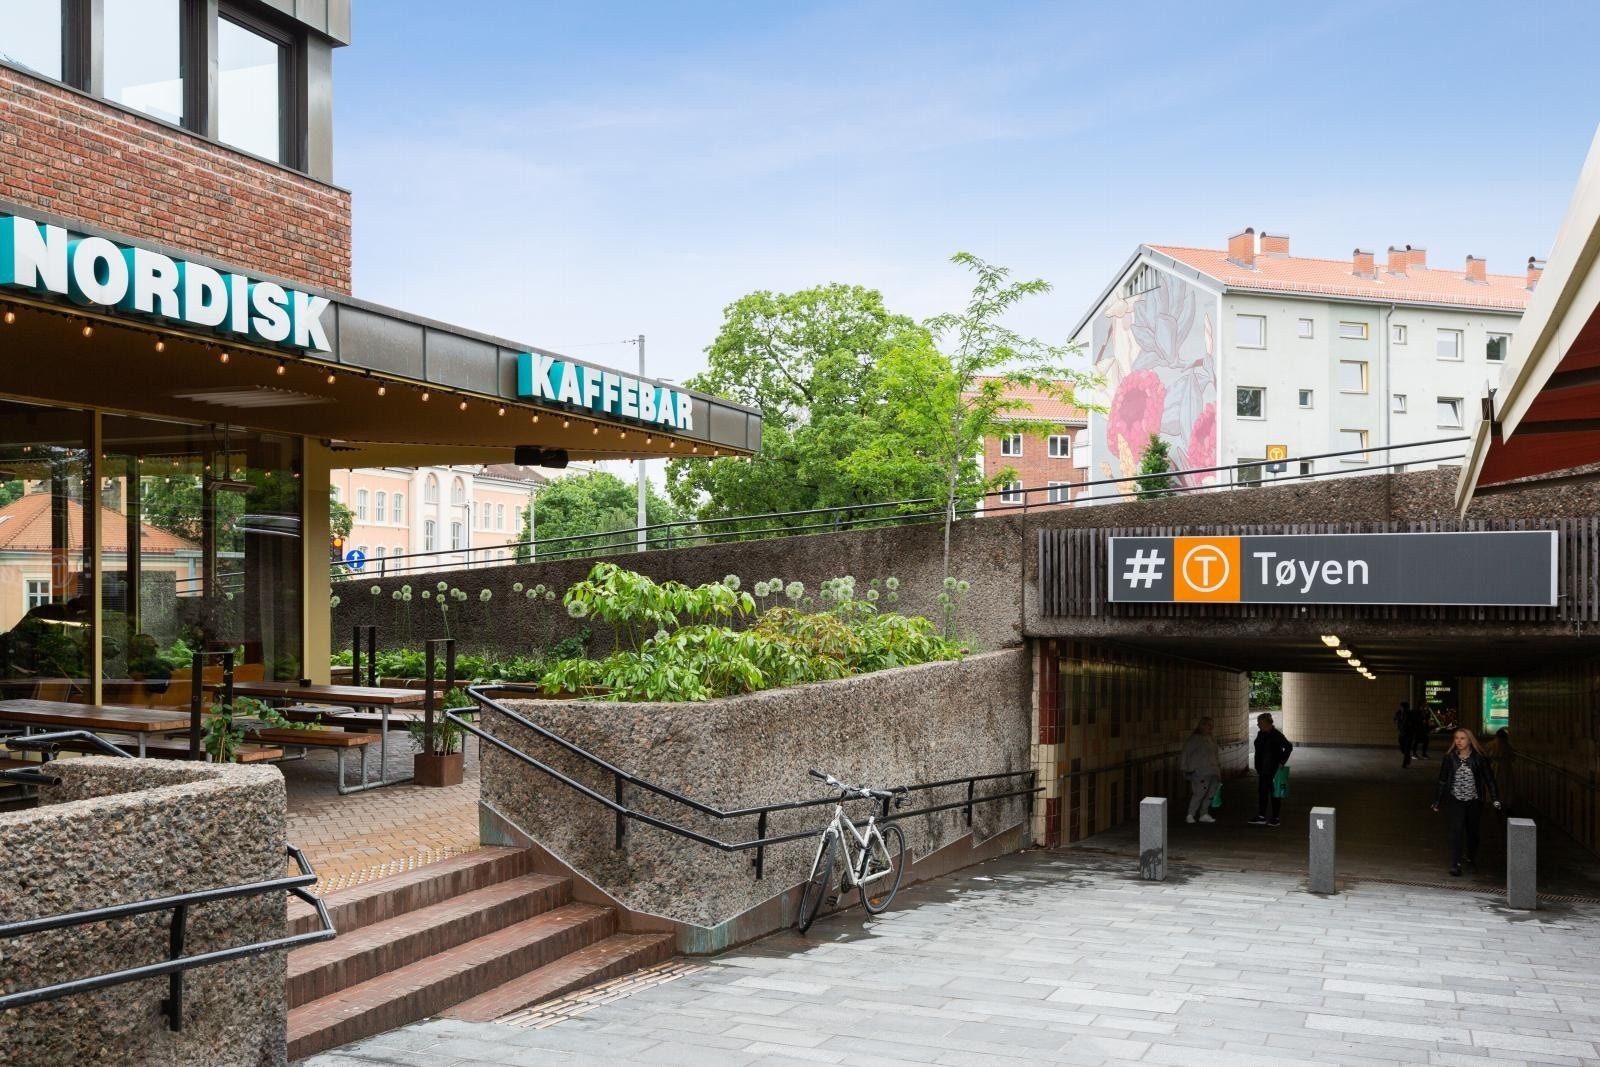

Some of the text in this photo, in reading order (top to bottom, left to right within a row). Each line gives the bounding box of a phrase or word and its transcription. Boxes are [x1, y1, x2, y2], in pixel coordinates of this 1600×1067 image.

[12, 215, 333, 352] NORDISK
[531, 352, 693, 431] KAFFEBAR
[1194, 556, 1217, 586] T
[1253, 552, 1369, 594] Tøyen
